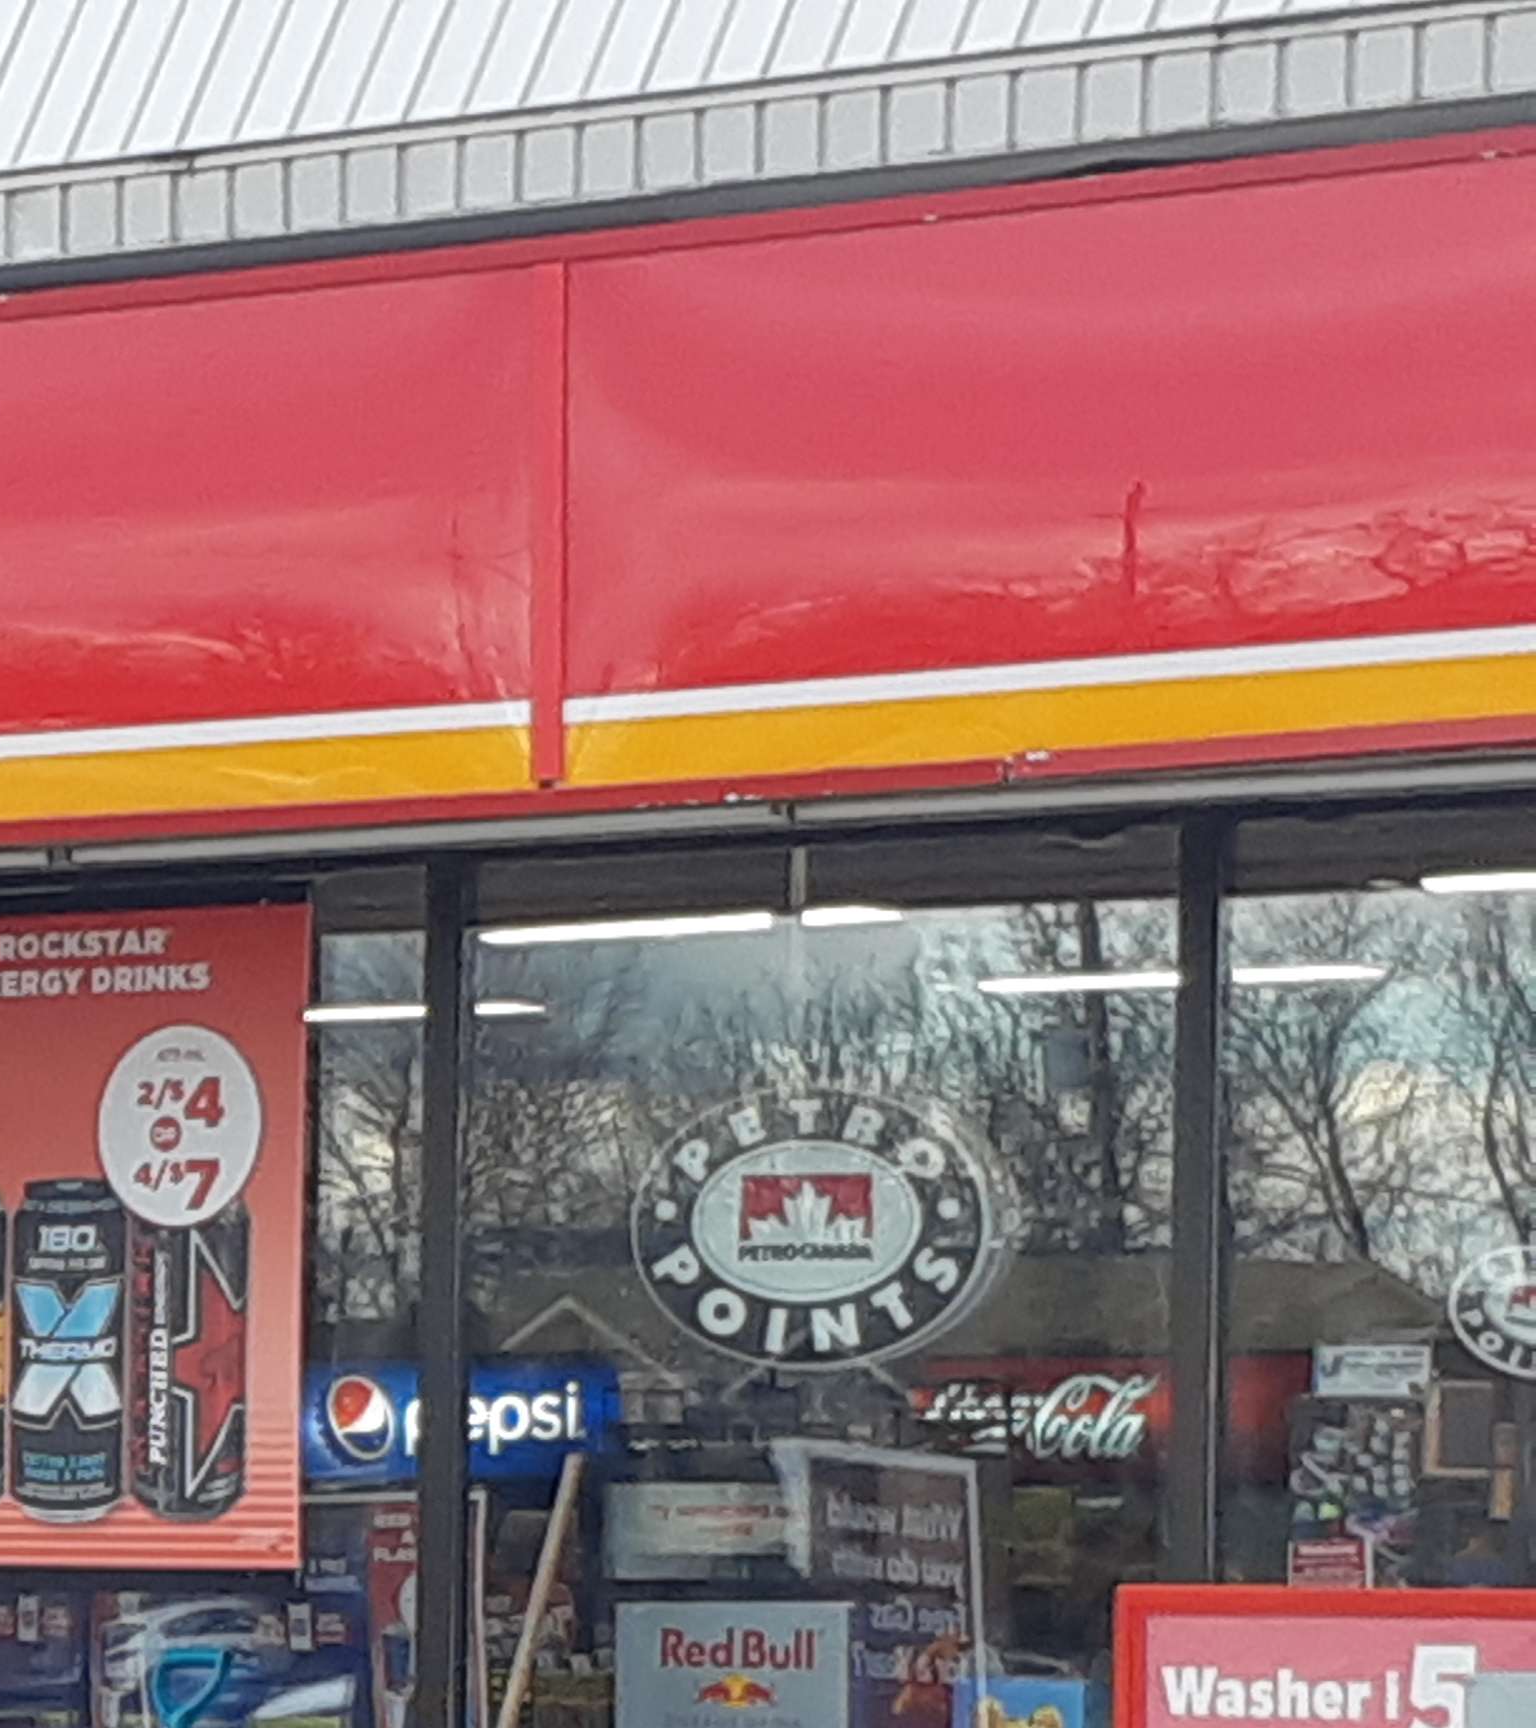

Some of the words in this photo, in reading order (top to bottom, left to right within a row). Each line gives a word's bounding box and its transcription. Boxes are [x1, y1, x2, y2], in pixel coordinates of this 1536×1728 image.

[90, 960, 213, 996] DRINKS
[673, 1098, 946, 1183] PETRO
[652, 1243, 960, 1353] POINTS
[19, 1337, 117, 1359] THERMO
[660, 1626, 736, 1668] Red
[741, 1628, 817, 1670] Bull
[1160, 1664, 1372, 1722] Washer
